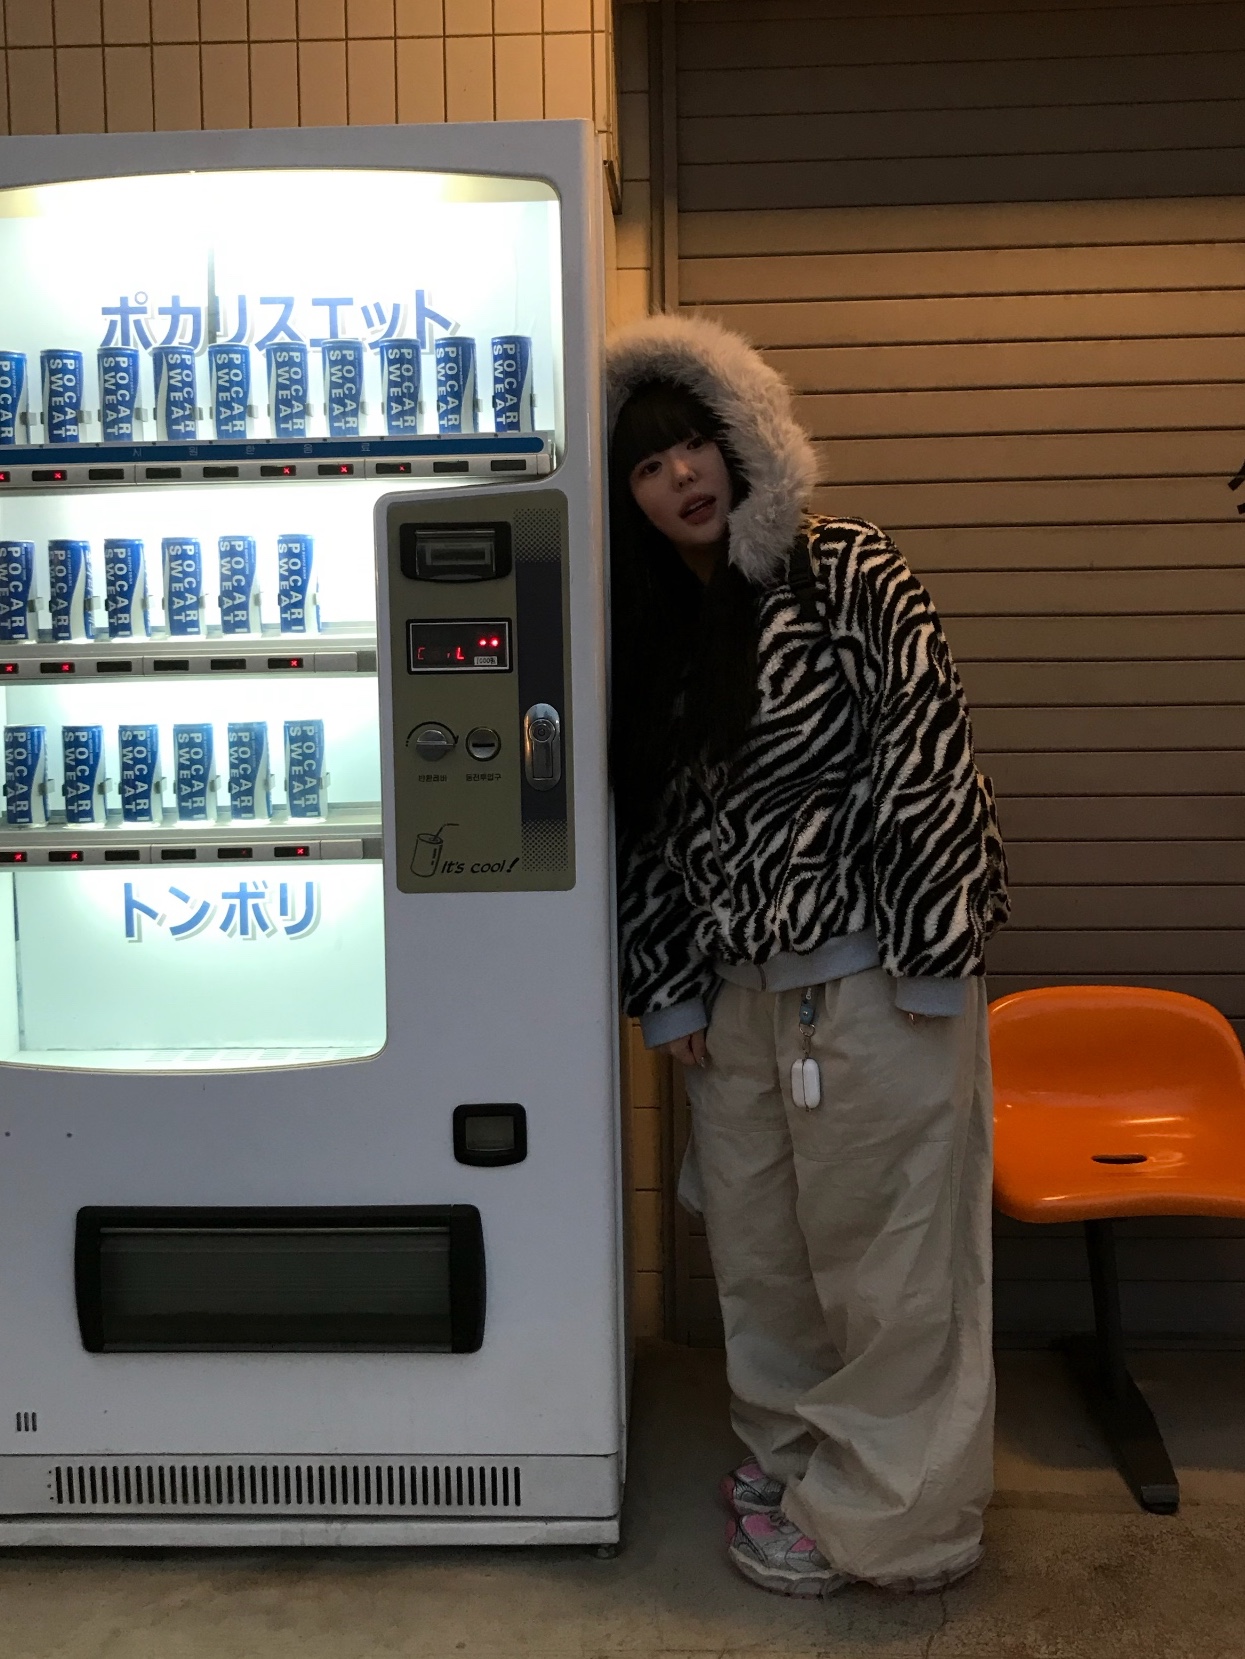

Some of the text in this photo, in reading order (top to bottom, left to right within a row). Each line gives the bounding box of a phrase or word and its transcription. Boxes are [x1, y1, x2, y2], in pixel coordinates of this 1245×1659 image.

[0, 360, 13, 438] POCAR
[50, 358, 65, 437] SWEAT
[63, 359, 78, 436] POCAR
[103, 357, 118, 436] SWEAT
[116, 357, 131, 434] POCAR
[168, 354, 185, 433] SWEAT
[182, 354, 196, 440] POCAR
[216, 354, 232, 433] SWEAT
[229, 354, 245, 431] POCAR
[276, 352, 292, 431] SWEAT
[289, 352, 305, 437] POCAR
[329, 350, 345, 429] SWEAT
[387, 349, 403, 428] SWEAT
[401, 349, 415, 426] POCAR
[436, 348, 448, 427] SWEAT
[445, 347, 460, 425] POCAR
[493, 345, 506, 425] SWEAT
[0, 547, 11, 629] SWEAT
[8, 547, 26, 638] POCARI
[54, 550, 70, 638] POCARI
[105, 548, 118, 626] SWEAT
[114, 548, 131, 636] POCARI
[169, 545, 185, 623] SWEAT
[182, 545, 198, 632] POCARI
[219, 541, 234, 624] SWEAT
[230, 541, 248, 633] POCARI
[278, 543, 291, 620] SWEAT
[288, 543, 304, 630] POCARI
[4, 732, 16, 813] SWEAT
[13, 732, 29, 822] POCARI
[64, 732, 78, 813] SWEAT
[75, 731, 92, 822] POCARI
[121, 730, 136, 812] SWEAT
[132, 730, 149, 821] POCARI
[177, 733, 192, 809] SWEAT
[189, 733, 205, 818] POCARI
[229, 733, 241, 808] SWEAT
[237, 732, 253, 818] POCARI
[289, 727, 305, 808] SWEAT
[301, 726, 318, 817] POCARI
[441, 860, 466, 874] It's
[123, 880, 315, 938] トンボリ
